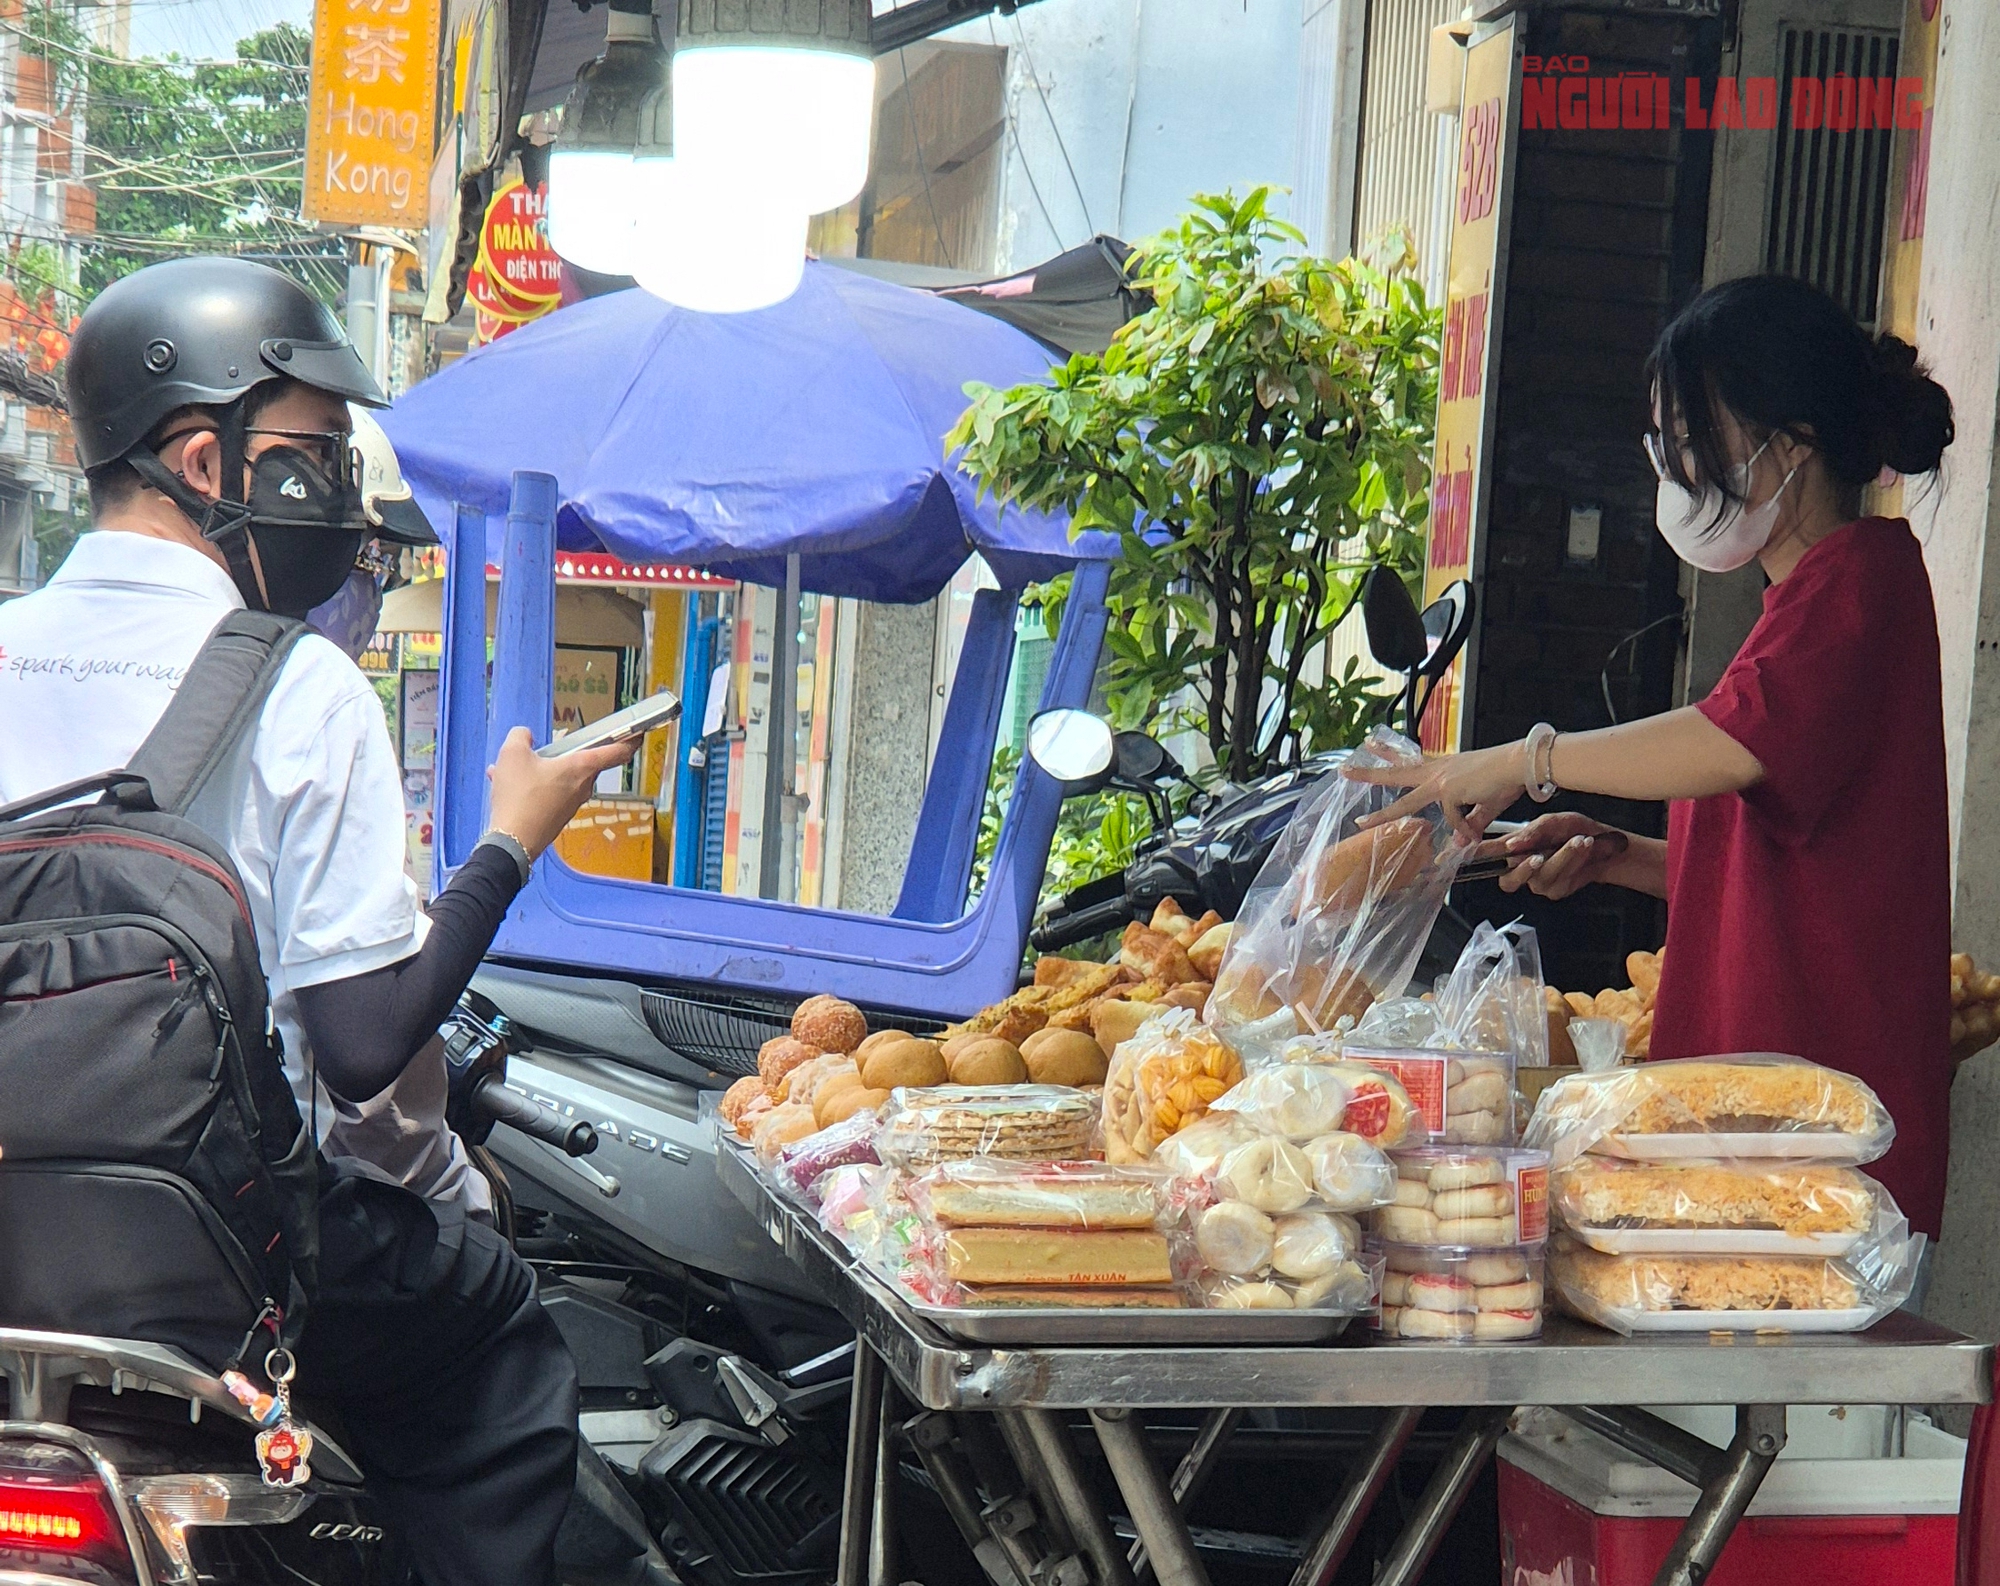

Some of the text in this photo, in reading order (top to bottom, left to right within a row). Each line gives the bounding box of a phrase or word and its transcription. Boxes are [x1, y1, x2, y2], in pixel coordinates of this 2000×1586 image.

[325, 90, 419, 152] Hong
[326, 150, 411, 209] Kong
[493, 217, 537, 251] MÀN
[506, 255, 537, 283] ĐIỆN
[1068, 1272, 1091, 1282] TÂN
[1093, 1272, 1127, 1282] XUÂN
